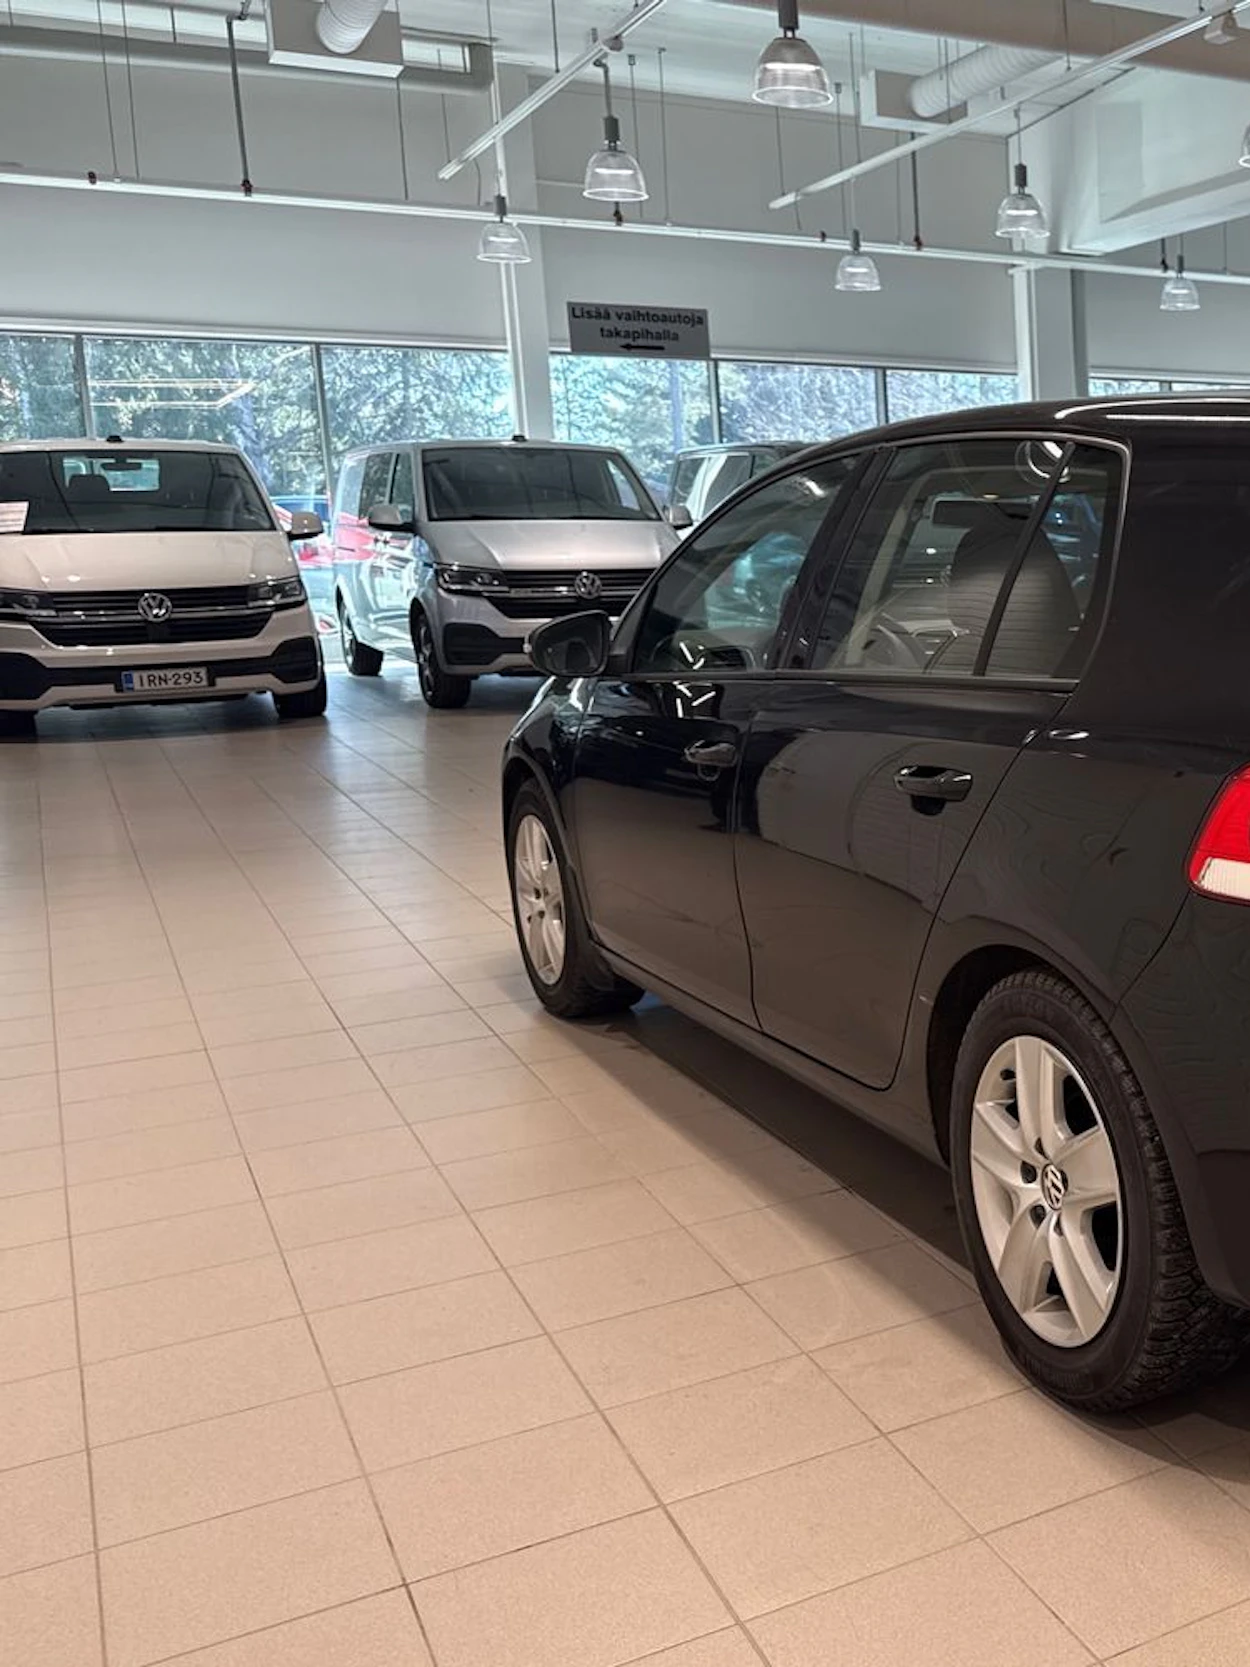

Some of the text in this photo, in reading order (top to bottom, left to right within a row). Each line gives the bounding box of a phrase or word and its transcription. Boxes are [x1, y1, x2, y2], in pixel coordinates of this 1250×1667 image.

[571, 306, 704, 328] Lisää vaihtoautoja
[600, 326, 680, 342] takapihalla
[139, 671, 204, 688] IRN-293
